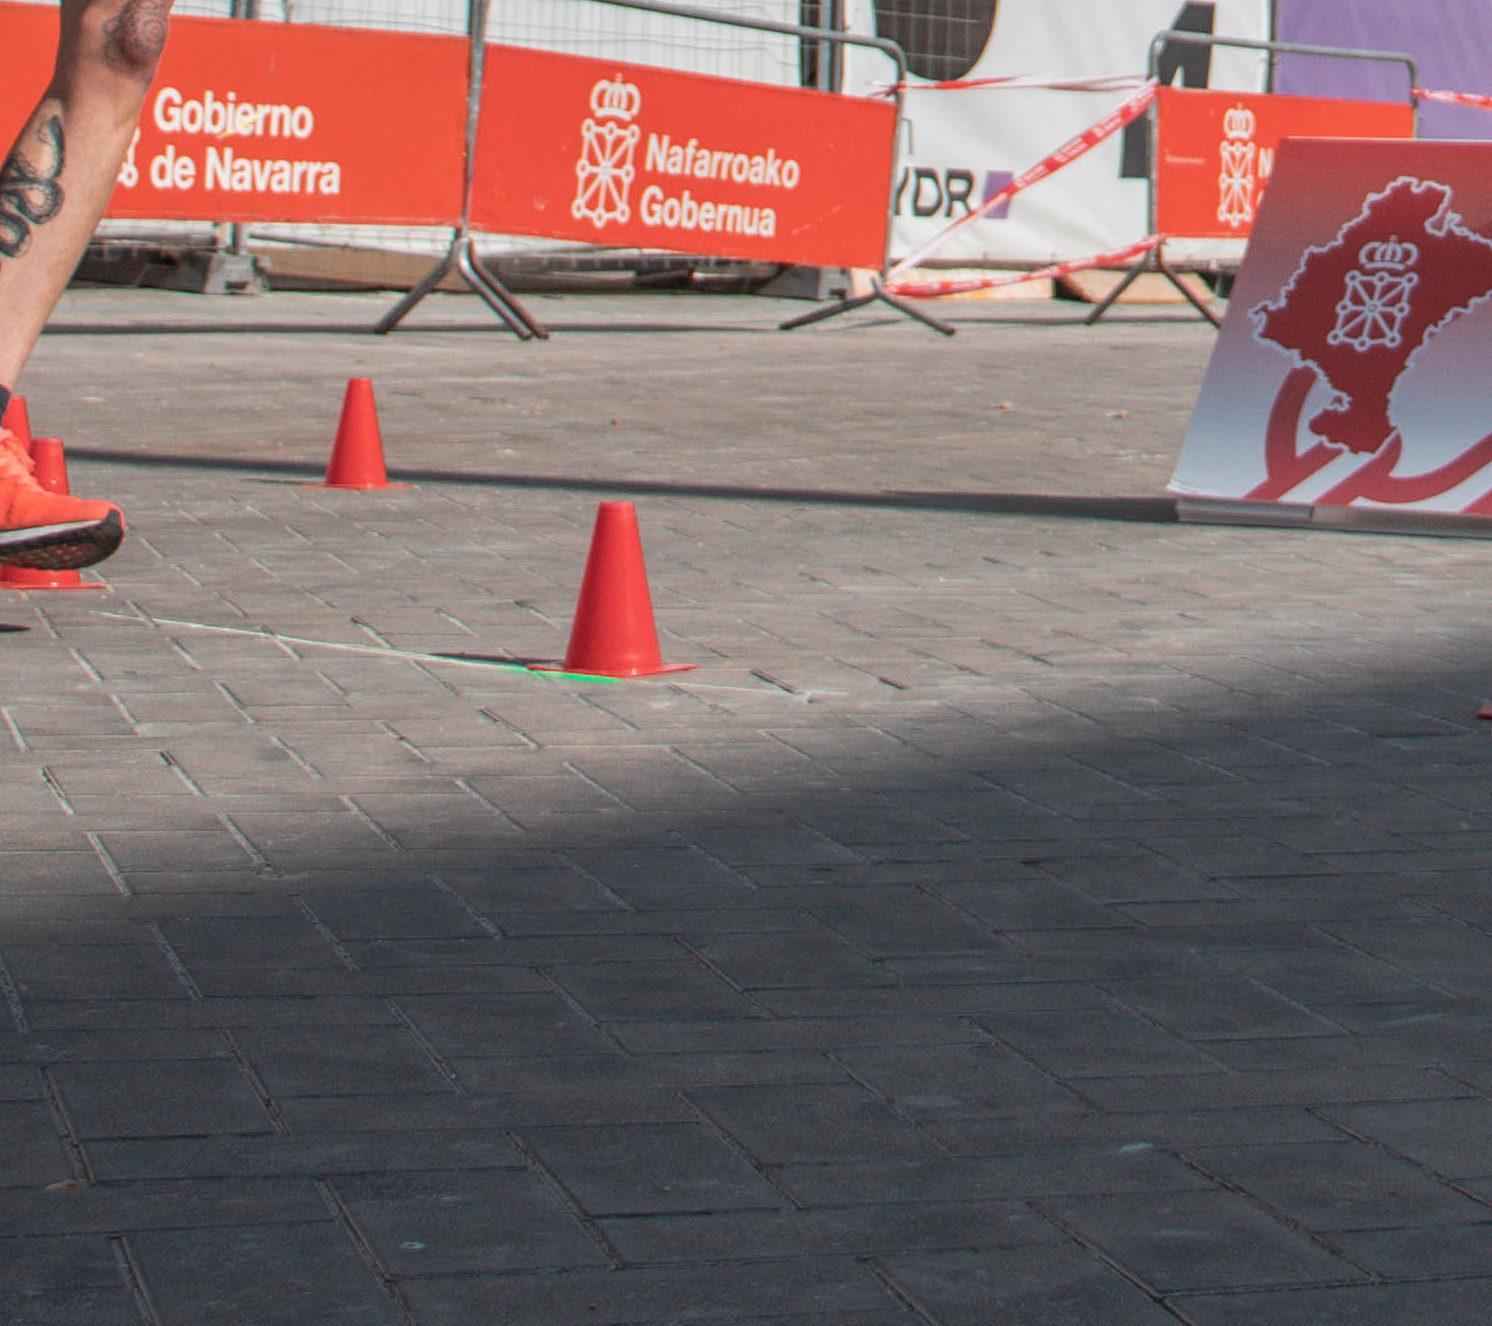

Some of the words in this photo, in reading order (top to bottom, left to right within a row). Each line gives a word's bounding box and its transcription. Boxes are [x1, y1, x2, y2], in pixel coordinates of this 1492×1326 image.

[154, 86, 314, 138] Gobierno
[150, 144, 196, 189] de
[205, 146, 341, 195] Navarra
[645, 132, 800, 189] Nafarroako
[640, 185, 776, 237] Gobernua
